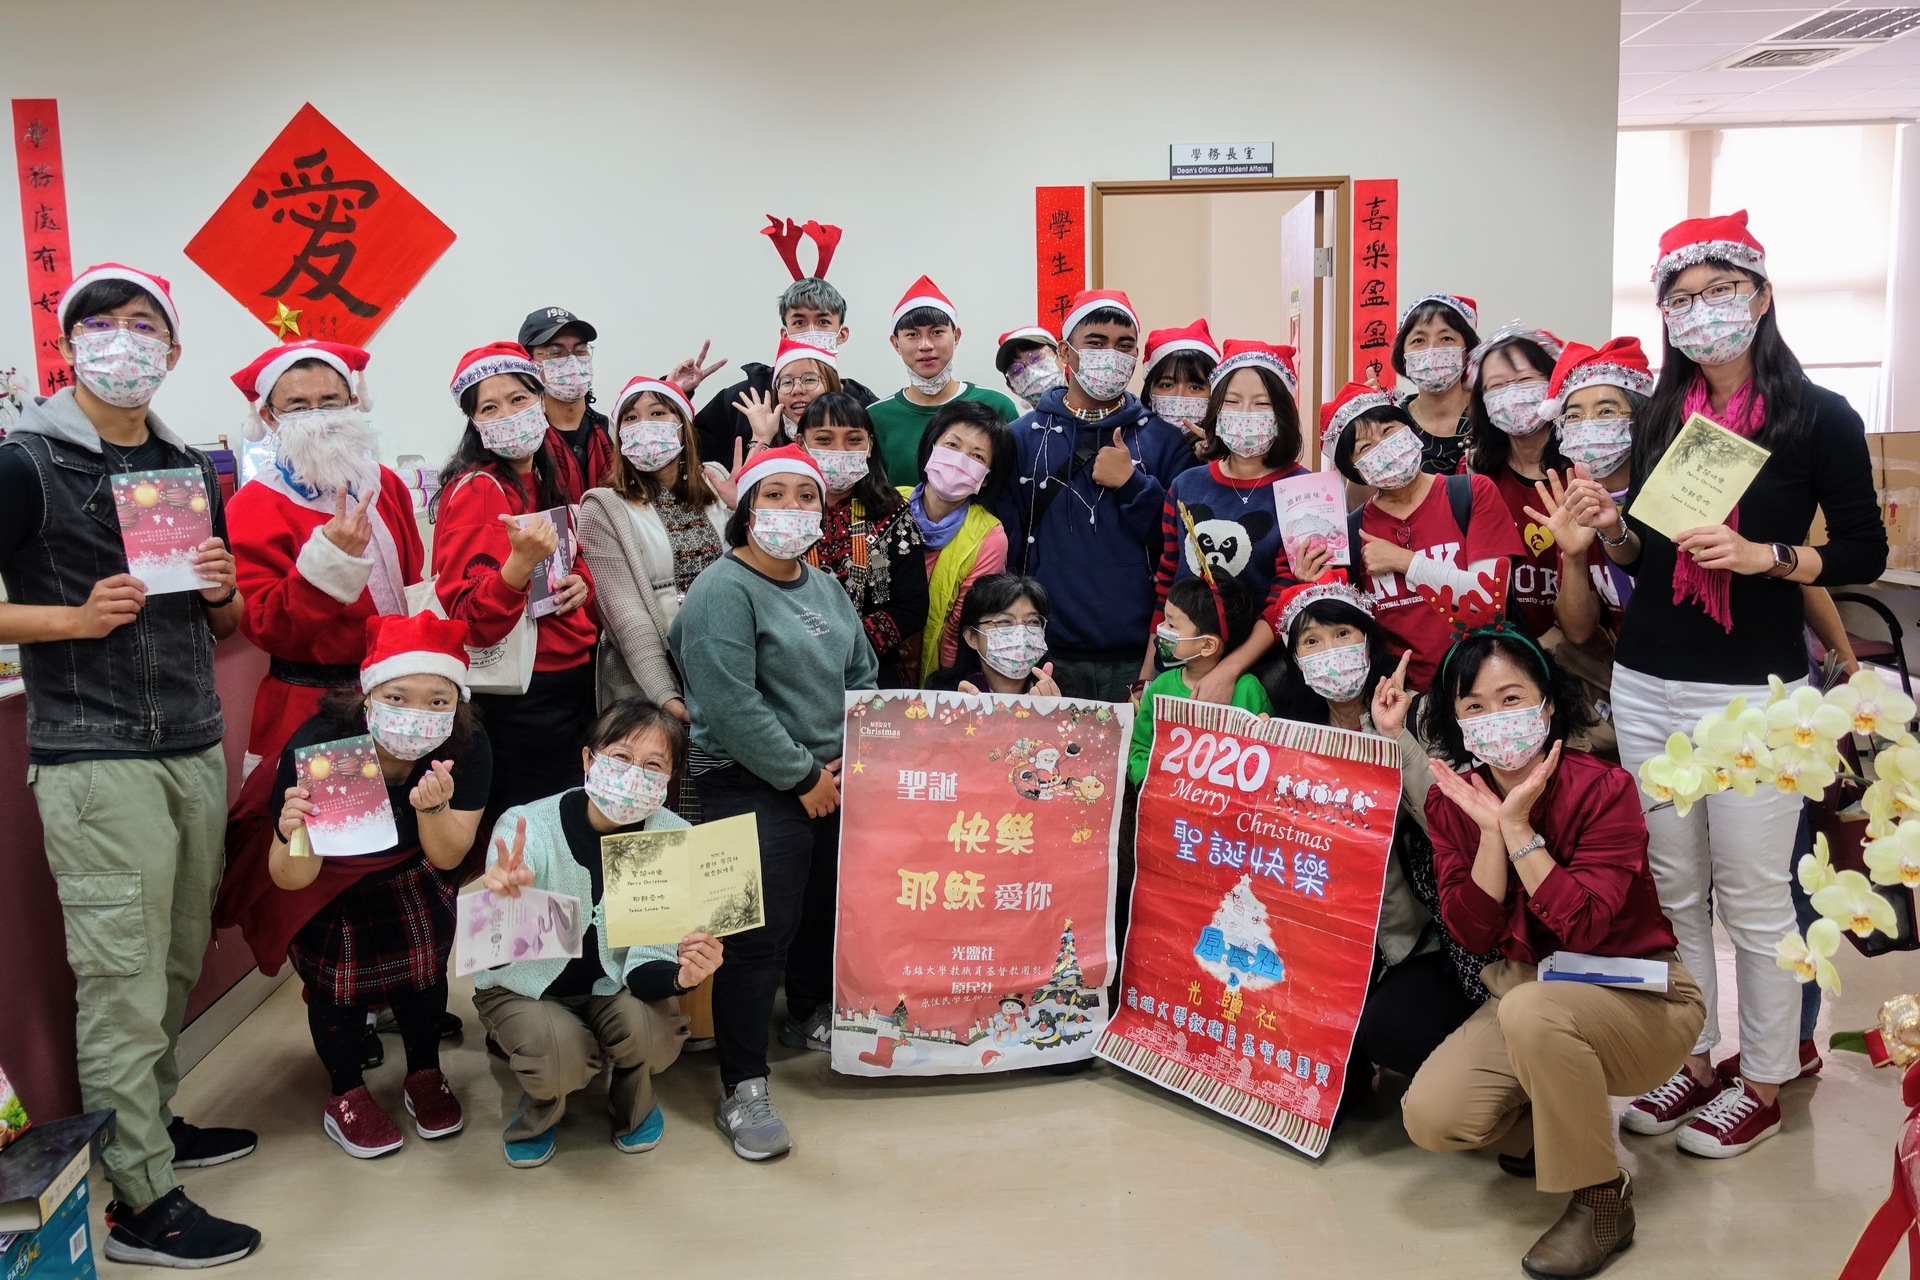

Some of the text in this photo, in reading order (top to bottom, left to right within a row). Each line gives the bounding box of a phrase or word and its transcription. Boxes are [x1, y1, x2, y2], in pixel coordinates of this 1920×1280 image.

[1190, 146, 1255, 161] 學務長室
[1198, 166, 1217, 174] Office
[1225, 165, 1248, 173] Student
[1249, 164, 1268, 172] Affairs
[252, 148, 381, 318] 愛
[1049, 209, 1074, 342] 學生平
[860, 726, 901, 736] Christmas
[1160, 727, 1271, 793] 2020
[897, 769, 958, 802] 聖誕
[1170, 778, 1231, 815] Merry
[948, 810, 1034, 855] 快樂
[1236, 812, 1333, 851] Christmas
[1173, 818, 1330, 898] 聖誕快樂
[896, 869, 1052, 911] 耶穌 愛你
[952, 945, 995, 962] 光鹽社
[1197, 929, 1278, 977] 原民社
[951, 981, 994, 994] 原民社
[1188, 980, 1277, 1031] 光鹽社
